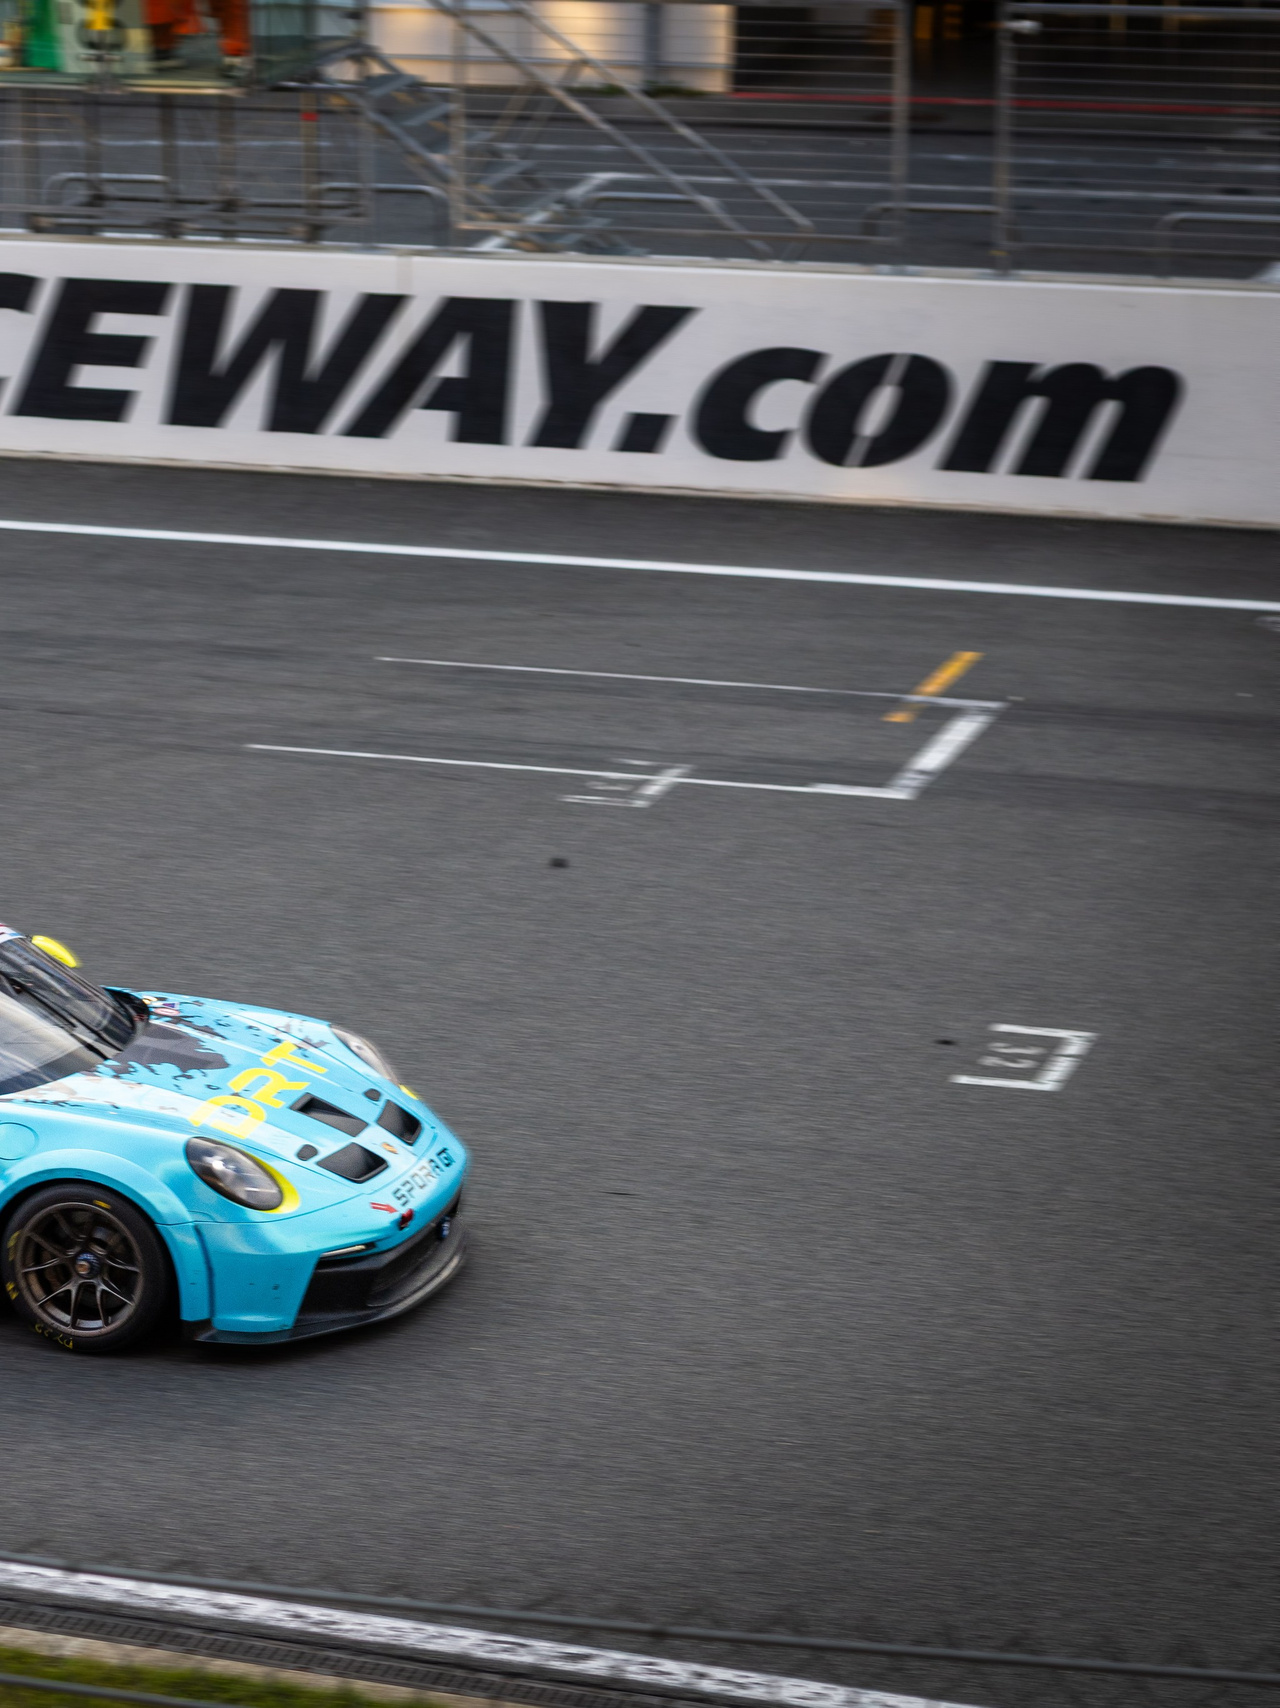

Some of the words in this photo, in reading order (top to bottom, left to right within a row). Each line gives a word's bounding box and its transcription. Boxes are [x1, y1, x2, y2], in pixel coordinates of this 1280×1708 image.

[187, 1041, 329, 1140] DRT
[392, 1158, 445, 1207] SPORA
[435, 1146, 456, 1167] GT
